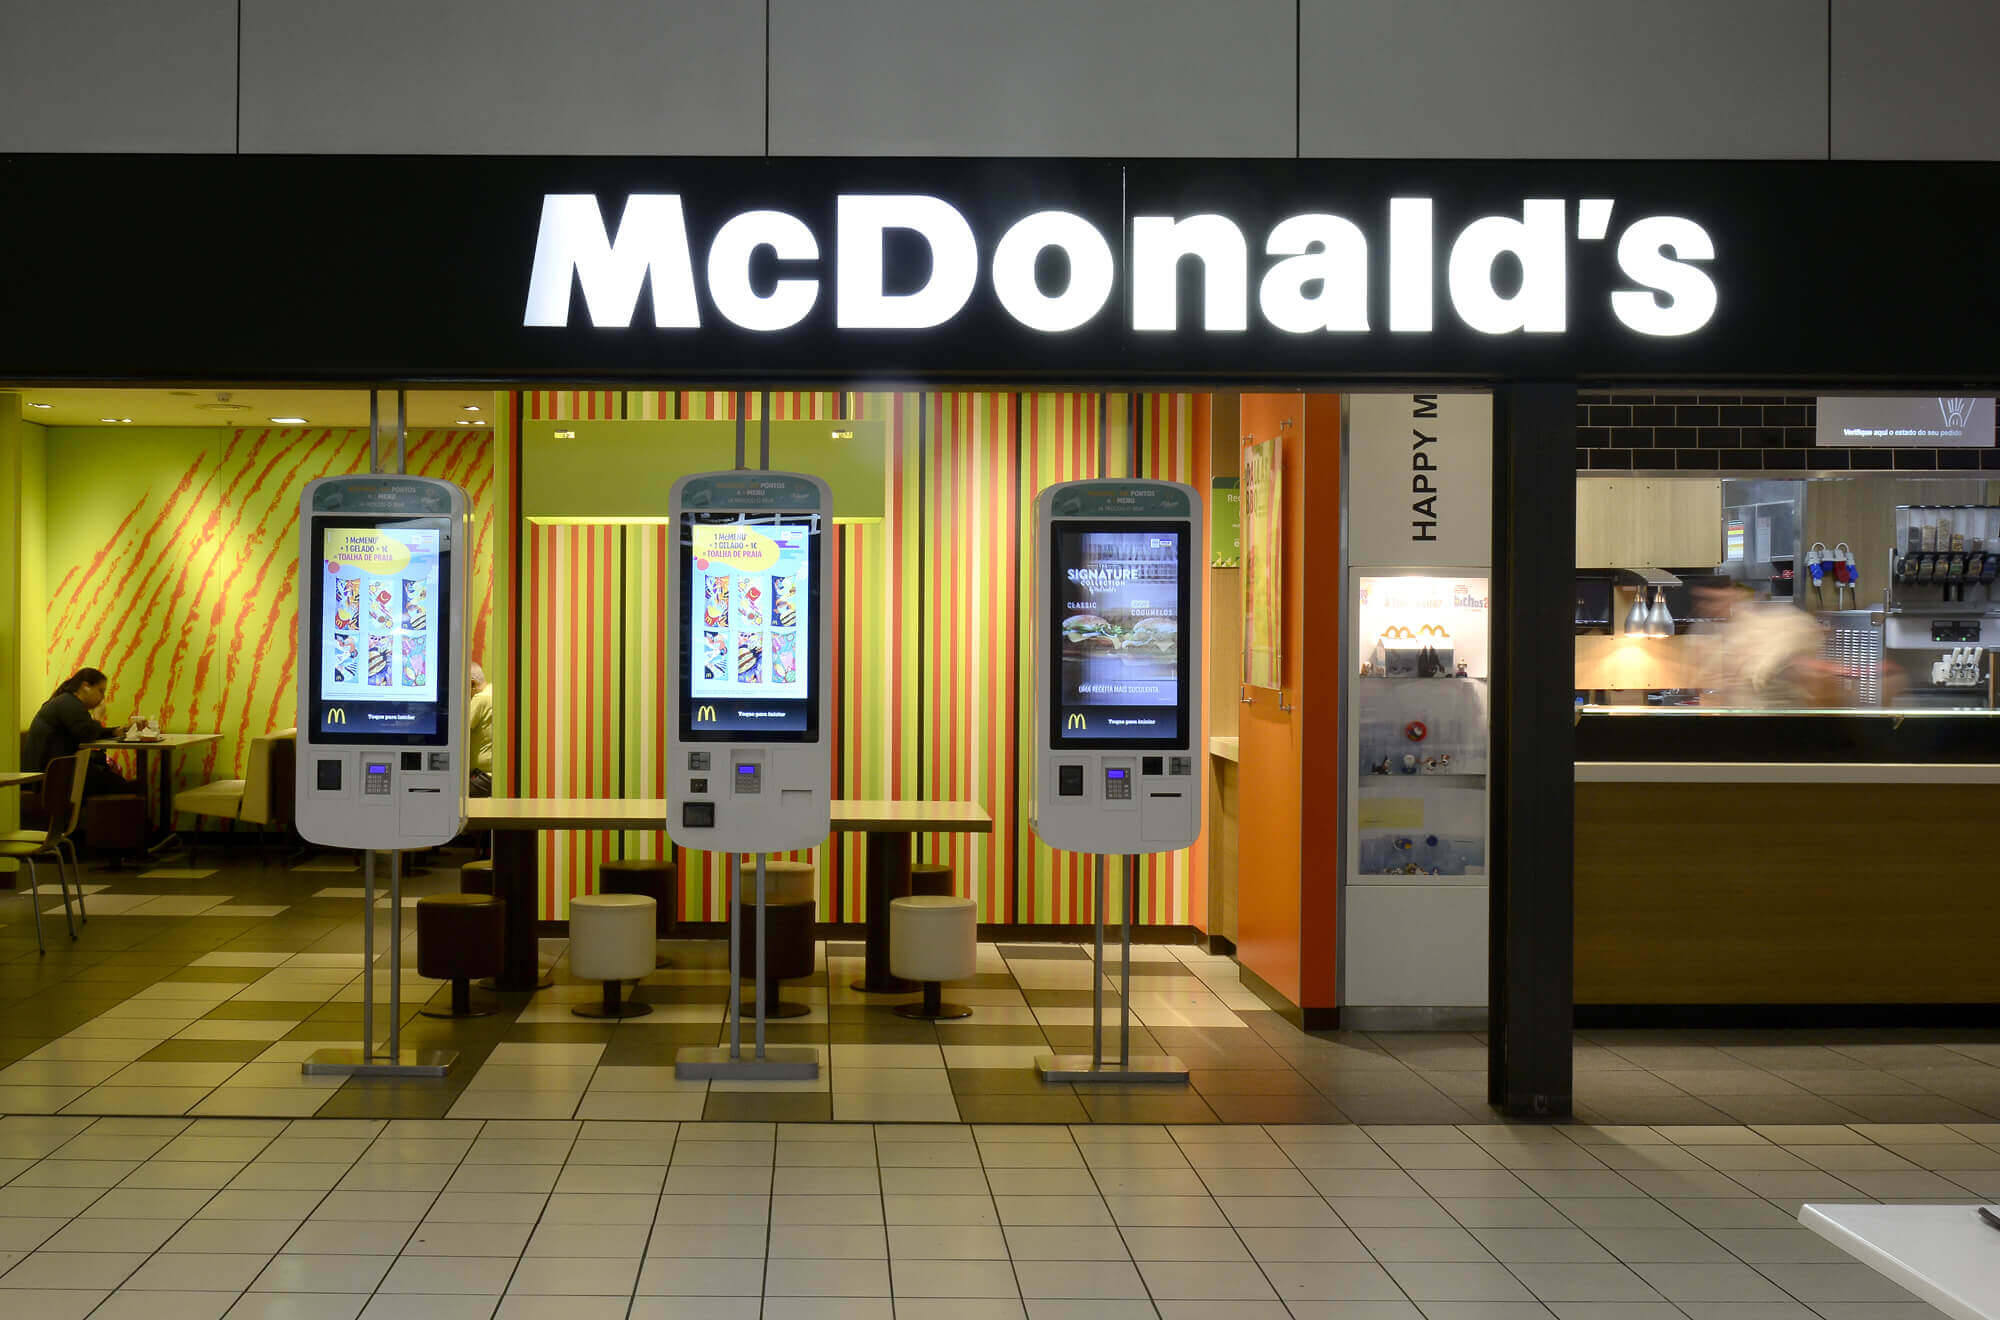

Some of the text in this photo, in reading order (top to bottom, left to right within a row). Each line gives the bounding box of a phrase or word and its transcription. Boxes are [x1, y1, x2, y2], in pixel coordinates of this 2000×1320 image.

[524, 194, 1717, 336] McDonald's
[1874, 429, 1888, 437] aqui
[1412, 429, 1438, 541] HAPPY
[338, 553, 362, 561] TOALHA
[364, 553, 372, 561] DE
[1067, 568, 1139, 580] SIGNATURE
